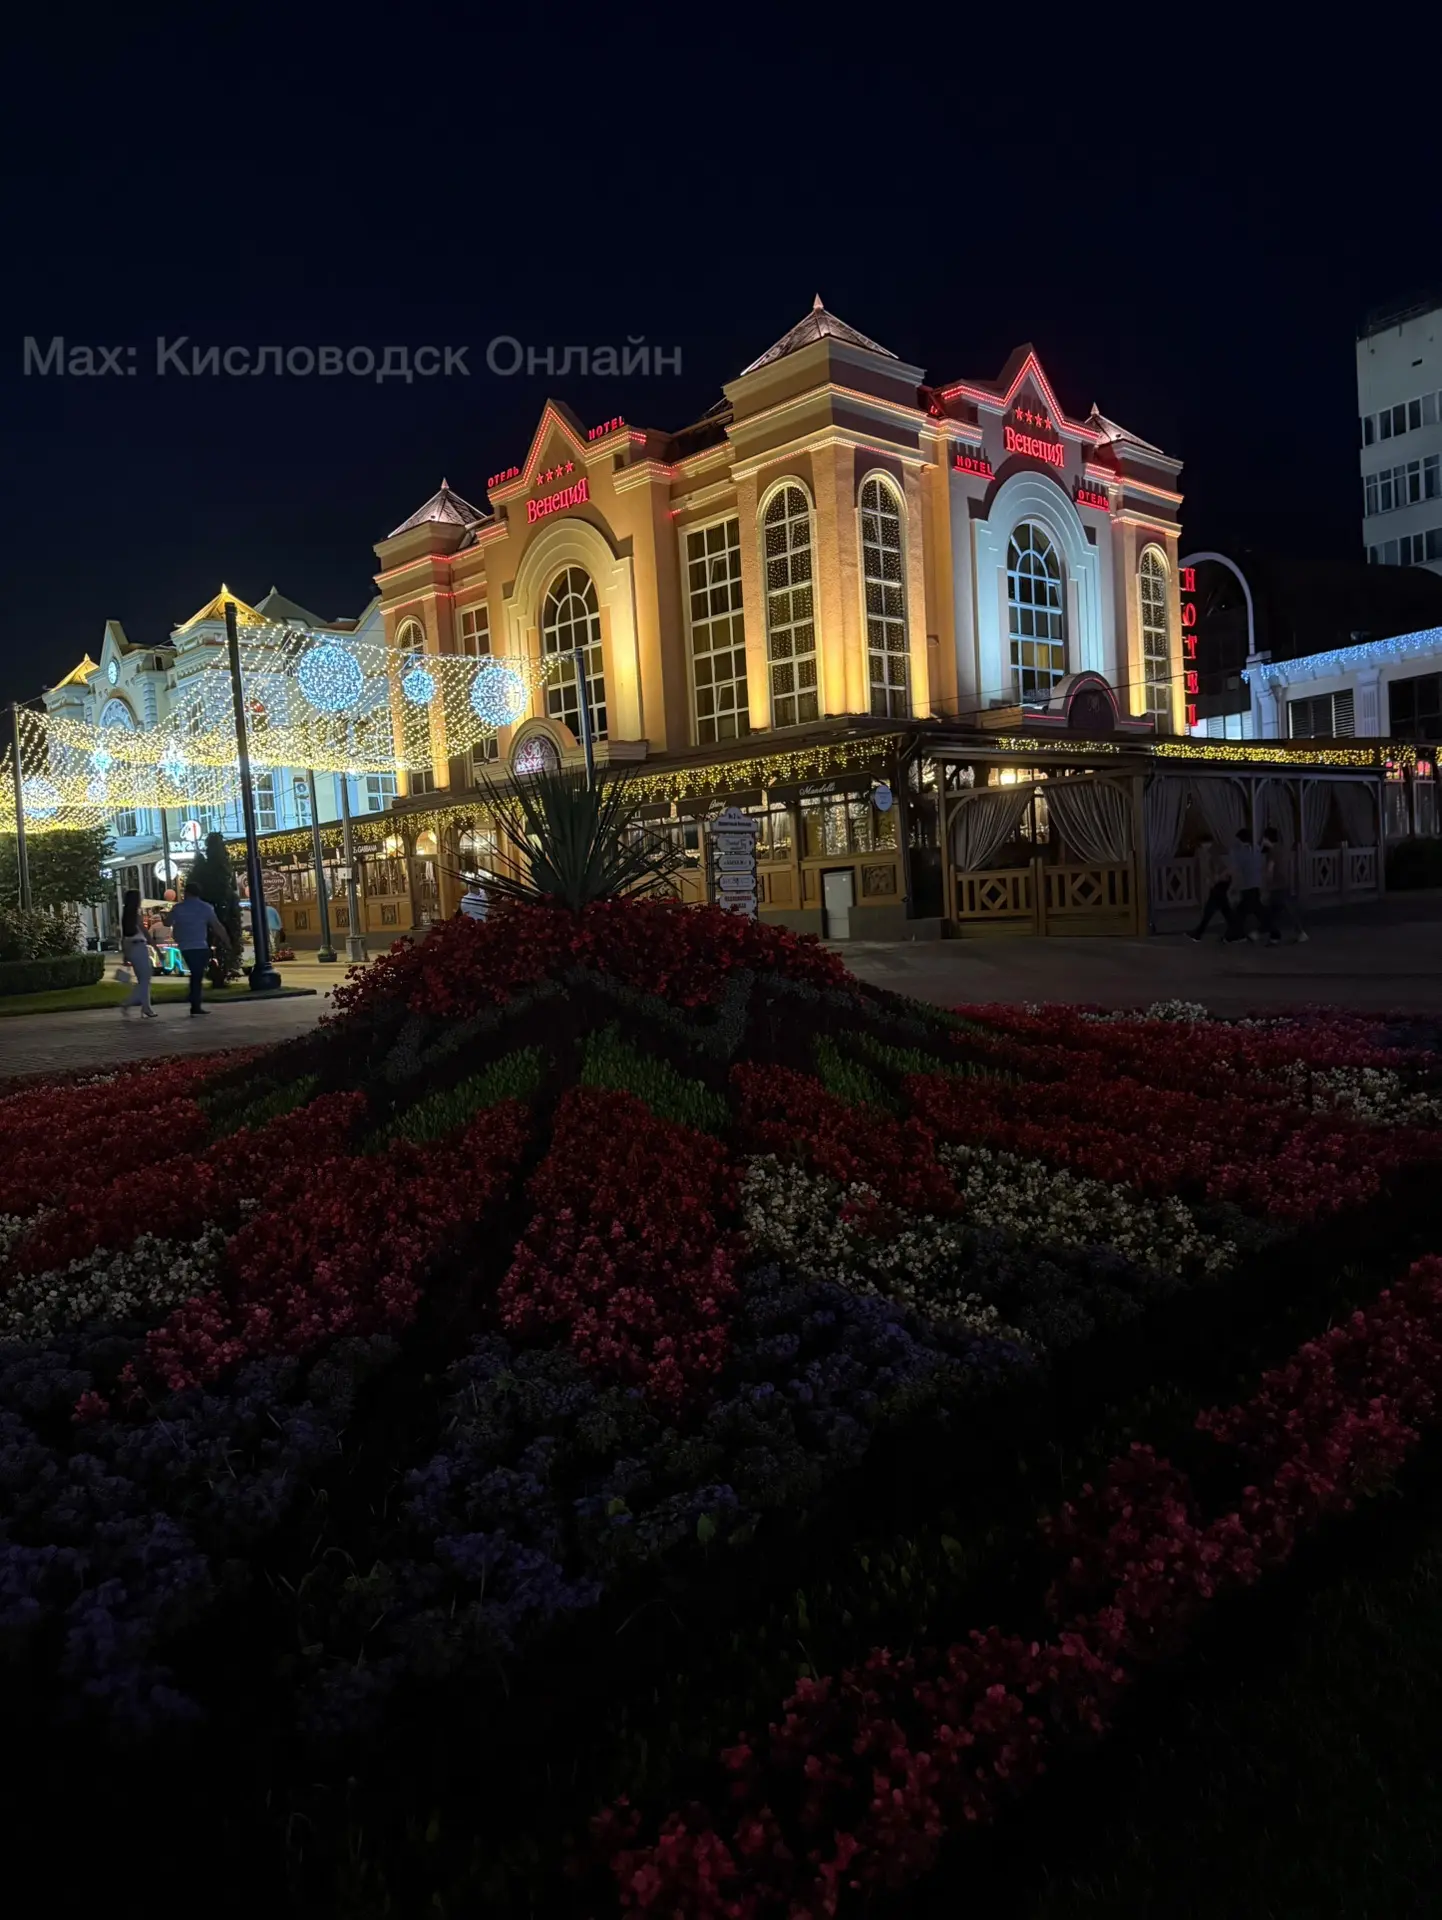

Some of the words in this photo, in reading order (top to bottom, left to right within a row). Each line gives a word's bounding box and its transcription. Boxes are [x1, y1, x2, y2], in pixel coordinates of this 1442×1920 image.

[588, 416, 625, 440] HOTEL
[956, 455, 993, 476] HOTEL
[487, 466, 520, 488] ОТЕЛЬ
[1078, 489, 1110, 507] ОТЕЛЬ
[1182, 567, 1199, 727] HOTEL
